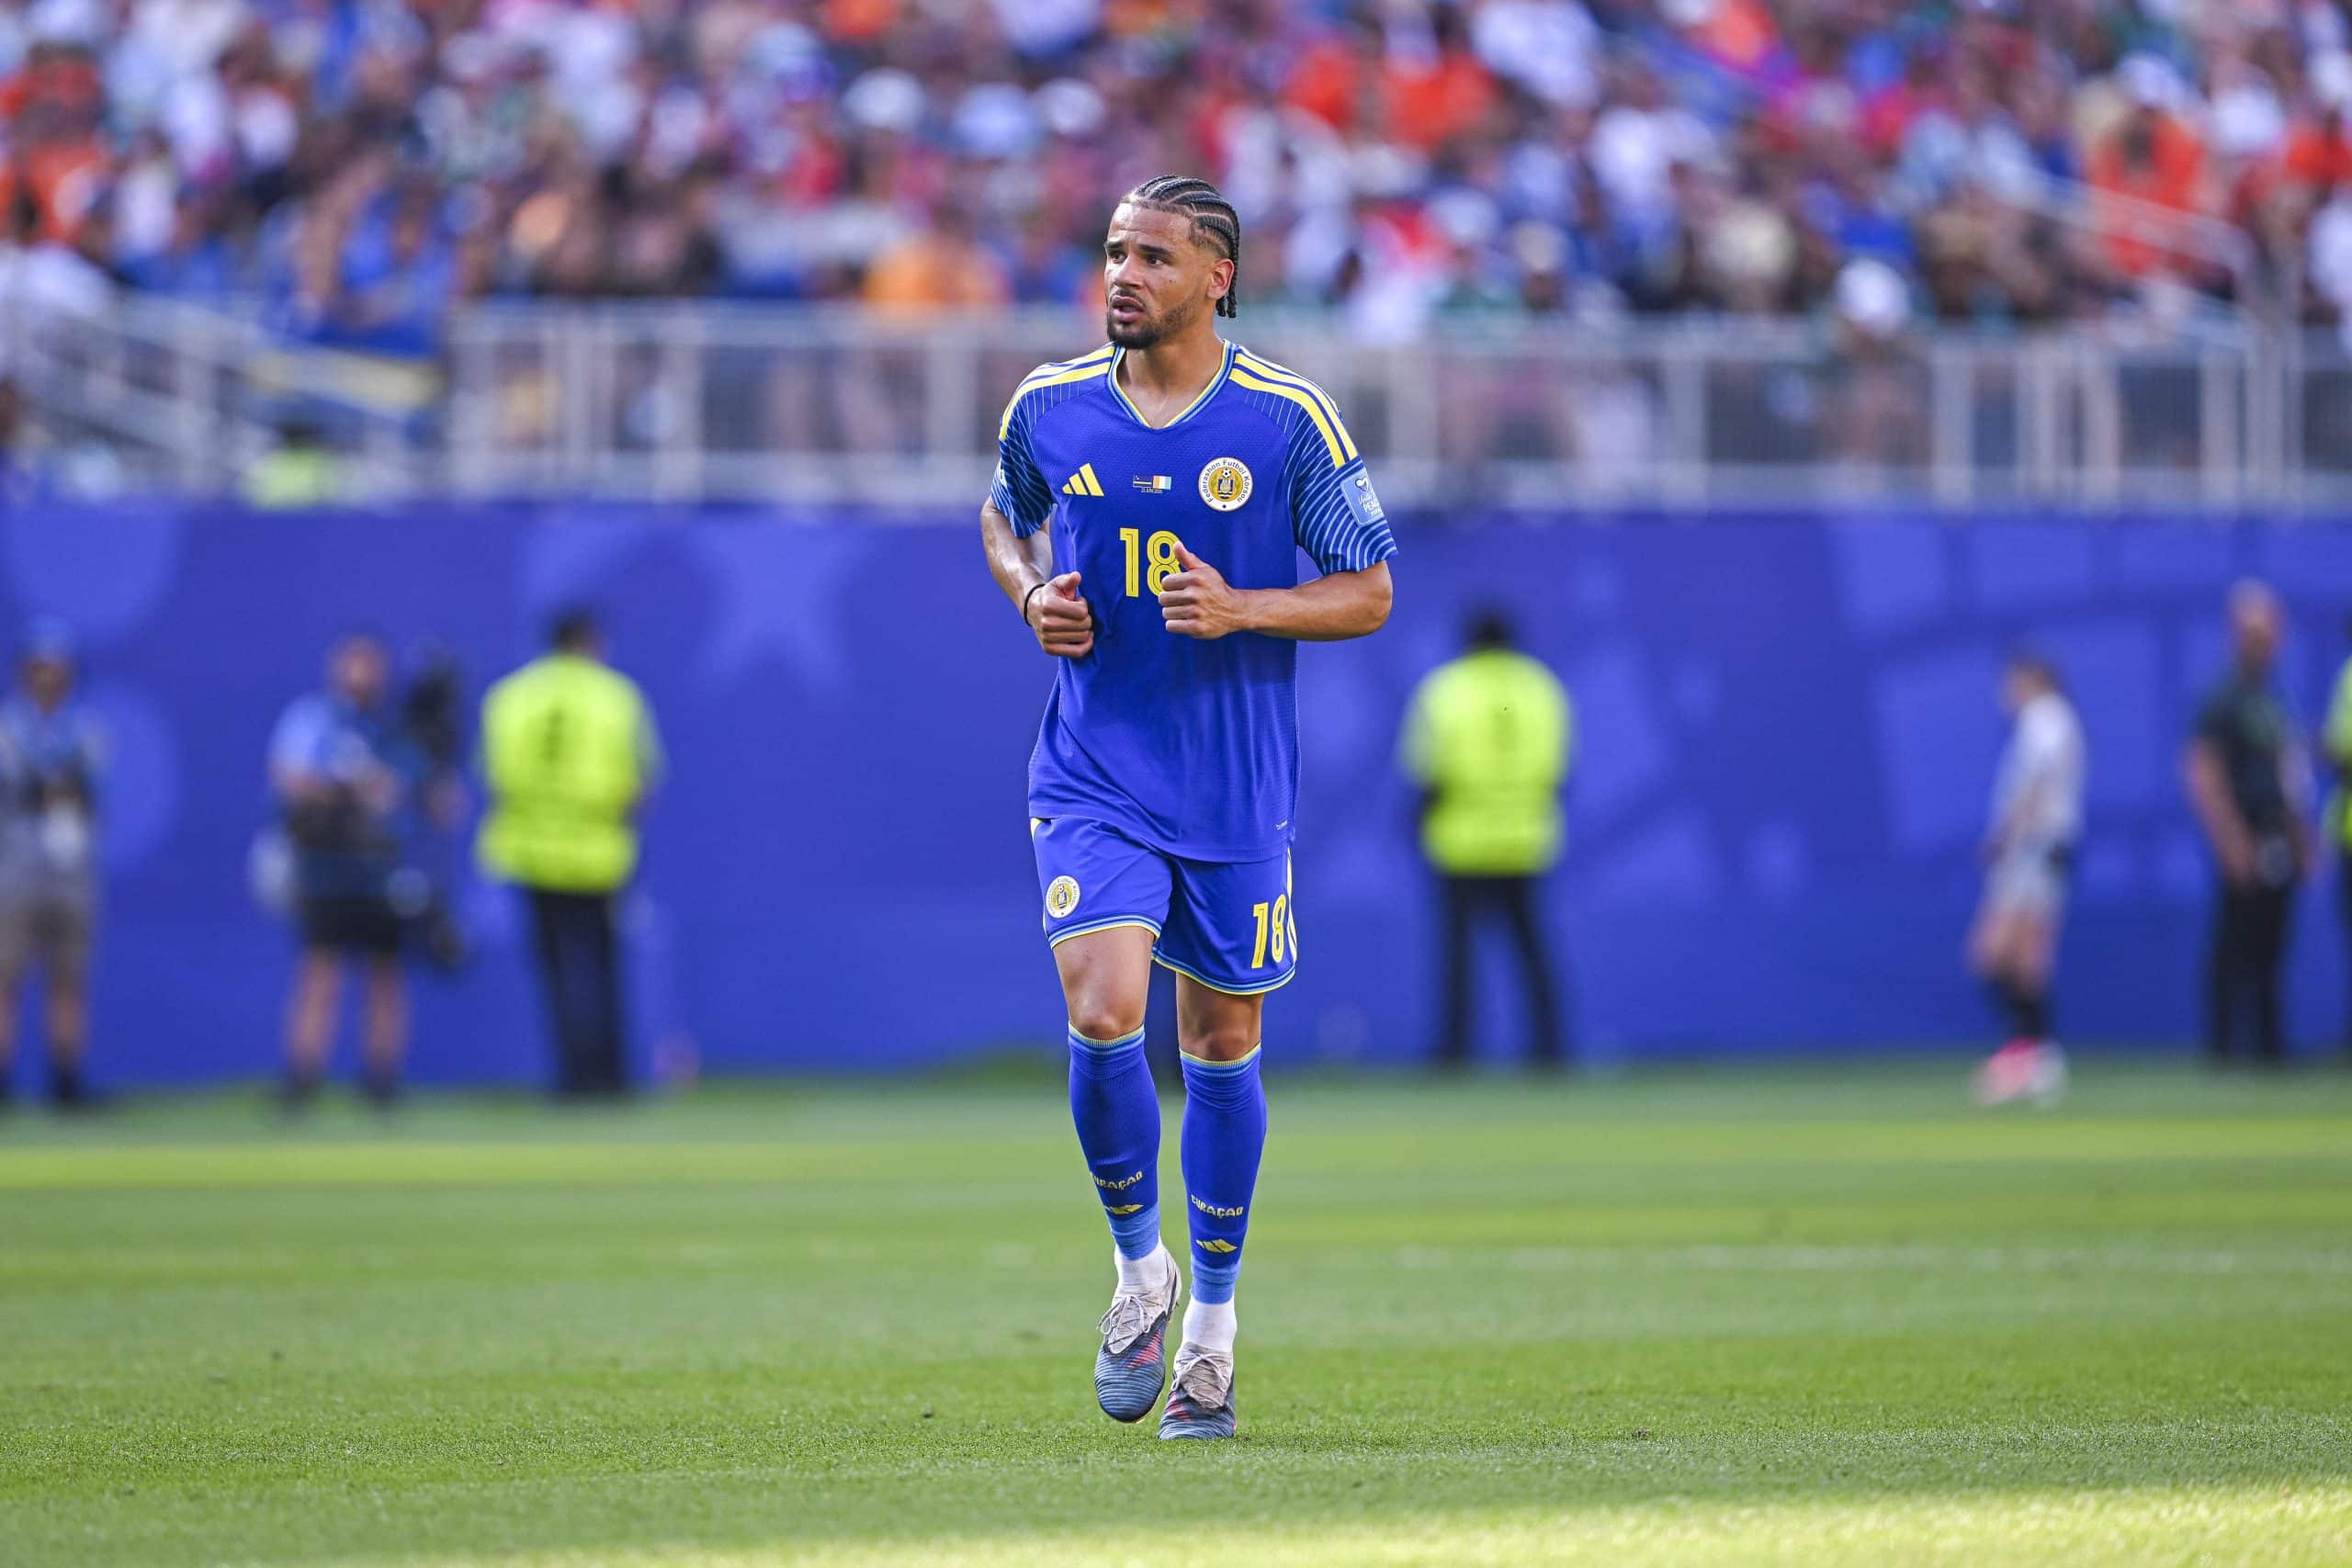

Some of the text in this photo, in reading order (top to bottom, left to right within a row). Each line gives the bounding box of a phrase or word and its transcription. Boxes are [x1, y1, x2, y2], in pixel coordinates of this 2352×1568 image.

[1222, 460, 1247, 475] Futbol
[1120, 527, 1182, 598] 18
[1251, 894, 1286, 969] 18
[1091, 1170, 1143, 1190] URAÇAO
[1191, 1194, 1244, 1219] CURAÇAO
